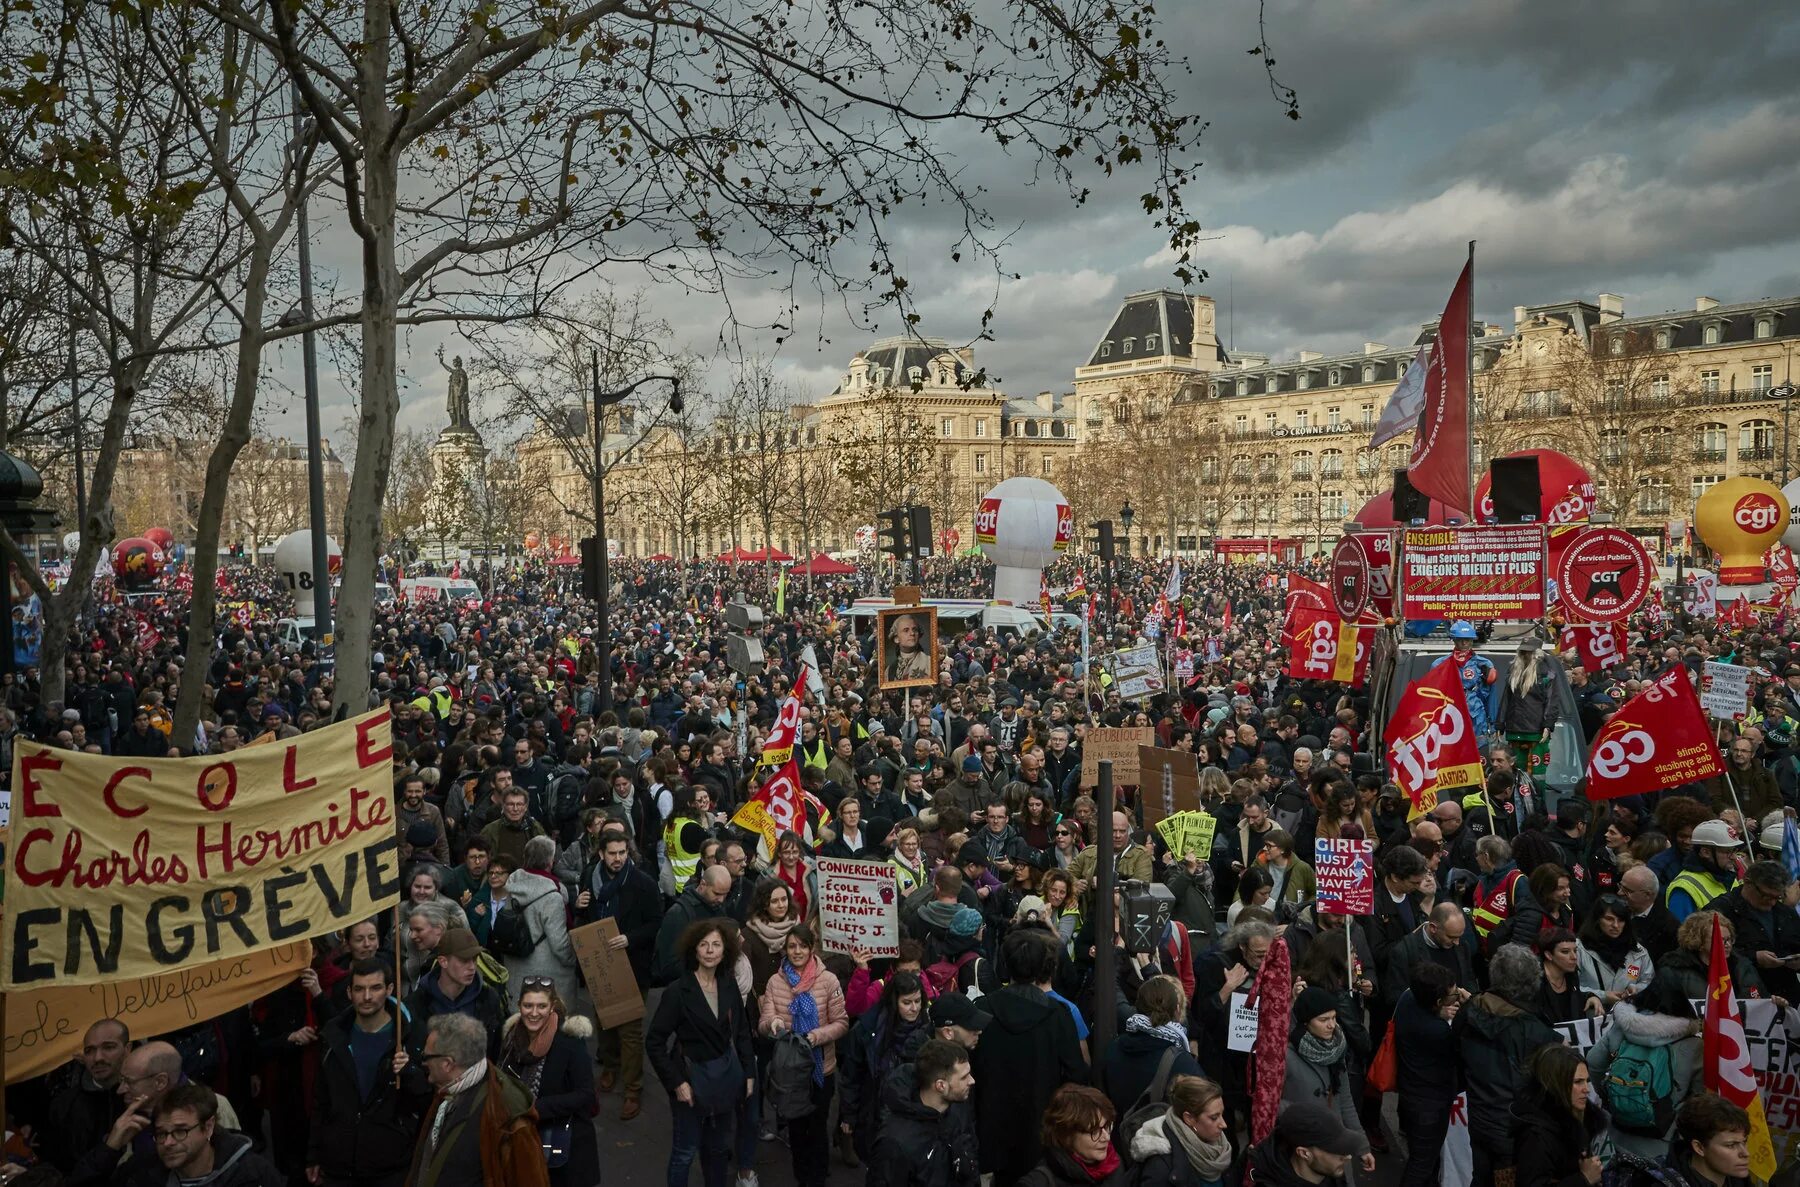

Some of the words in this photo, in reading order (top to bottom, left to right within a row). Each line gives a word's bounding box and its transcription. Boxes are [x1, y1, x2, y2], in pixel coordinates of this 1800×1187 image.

[1290, 426, 1324, 436] CROWNE
[1326, 423, 1352, 432] PLAZA
[976, 509, 997, 532] cgt
[1736, 504, 1777, 529] cgt
[1374, 538, 1391, 552] 92
[1484, 542, 1541, 550] Assainissement
[1406, 554, 1426, 564] POUR
[1428, 555, 1438, 564] un
[1439, 553, 1470, 563] Service
[1472, 552, 1498, 562] Public
[1498, 552, 1509, 562] de
[1511, 550, 1542, 562] Qualité
[1564, 535, 1604, 570] Assainissement
[1411, 564, 1459, 576] EXIGEONS
[1462, 564, 1493, 576] MIEUX
[1495, 563, 1506, 574] ET
[1509, 562, 1536, 574] PLUS
[1344, 576, 1356, 586] CGT
[1592, 572, 1620, 582] CGT
[1424, 602, 1446, 610] Public
[1451, 602, 1470, 610] Privé
[1470, 602, 1493, 610] même
[1594, 597, 1617, 606] Paris
[1444, 610, 1502, 618] cgt-ftdneea.fr
[21, 709, 394, 818] ÉCOLE
[15, 828, 189, 889] Charles
[197, 787, 392, 880] Hermite
[1316, 838, 1373, 854] GIRLS
[1316, 854, 1348, 866] JUST
[818, 860, 896, 878] CONVERGENCE
[1316, 866, 1368, 878] WANNA
[826, 879, 860, 893] ÉCOLE
[1316, 878, 1352, 890] HAVE
[1316, 890, 1342, 900] FUN
[12, 904, 124, 984] EN
[145, 835, 401, 965] GRÈVE
[3, 1000, 78, 1052] cole
